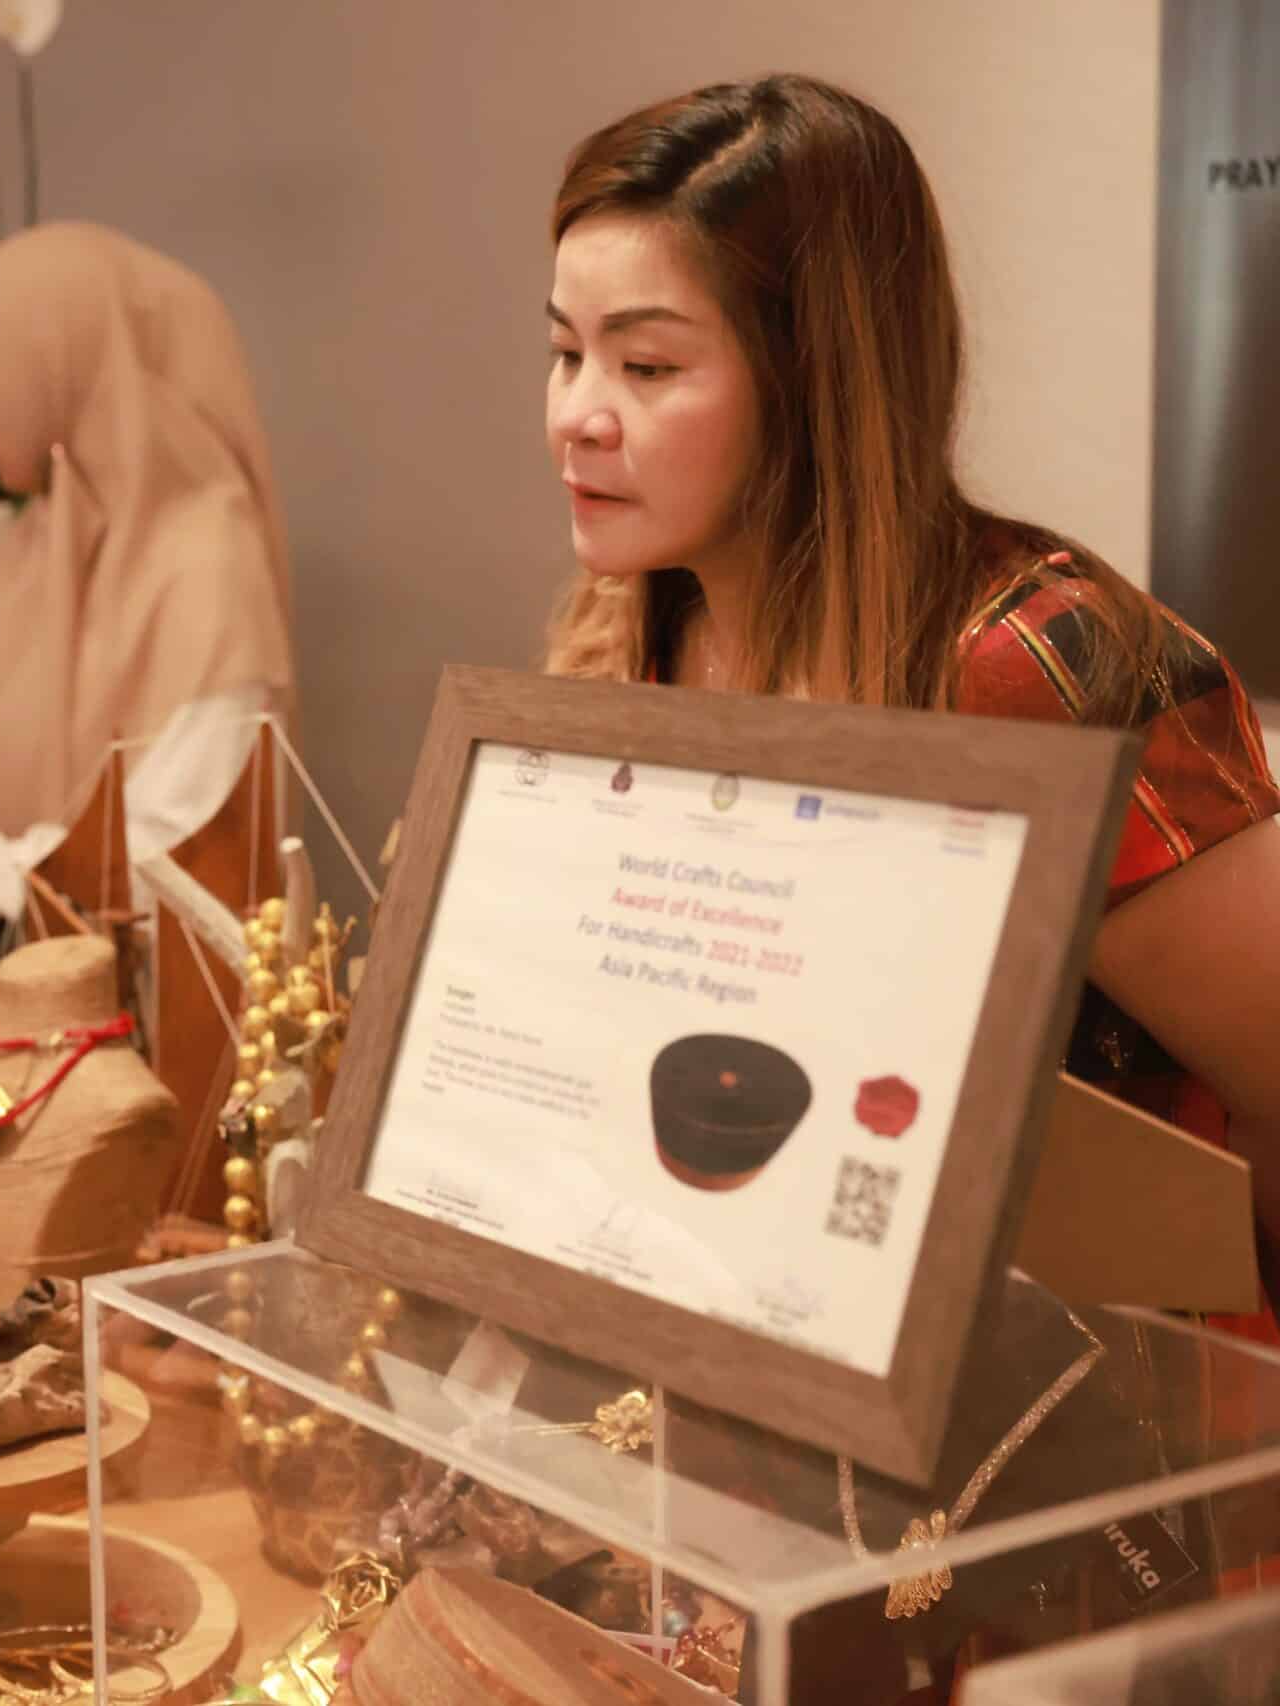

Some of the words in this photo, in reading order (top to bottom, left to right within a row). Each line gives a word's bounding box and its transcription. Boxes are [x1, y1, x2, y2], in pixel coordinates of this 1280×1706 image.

[618, 853, 669, 879] World
[672, 861, 722, 888] Crafts
[727, 869, 795, 899] Council
[612, 886, 665, 912] Award
[670, 897, 688, 916] of
[692, 899, 784, 935] Excellence
[577, 913, 604, 936] For
[607, 920, 703, 957] Handicrafts
[598, 953, 633, 979] Asia
[637, 960, 690, 991] Pacific
[696, 973, 758, 1005] Region
